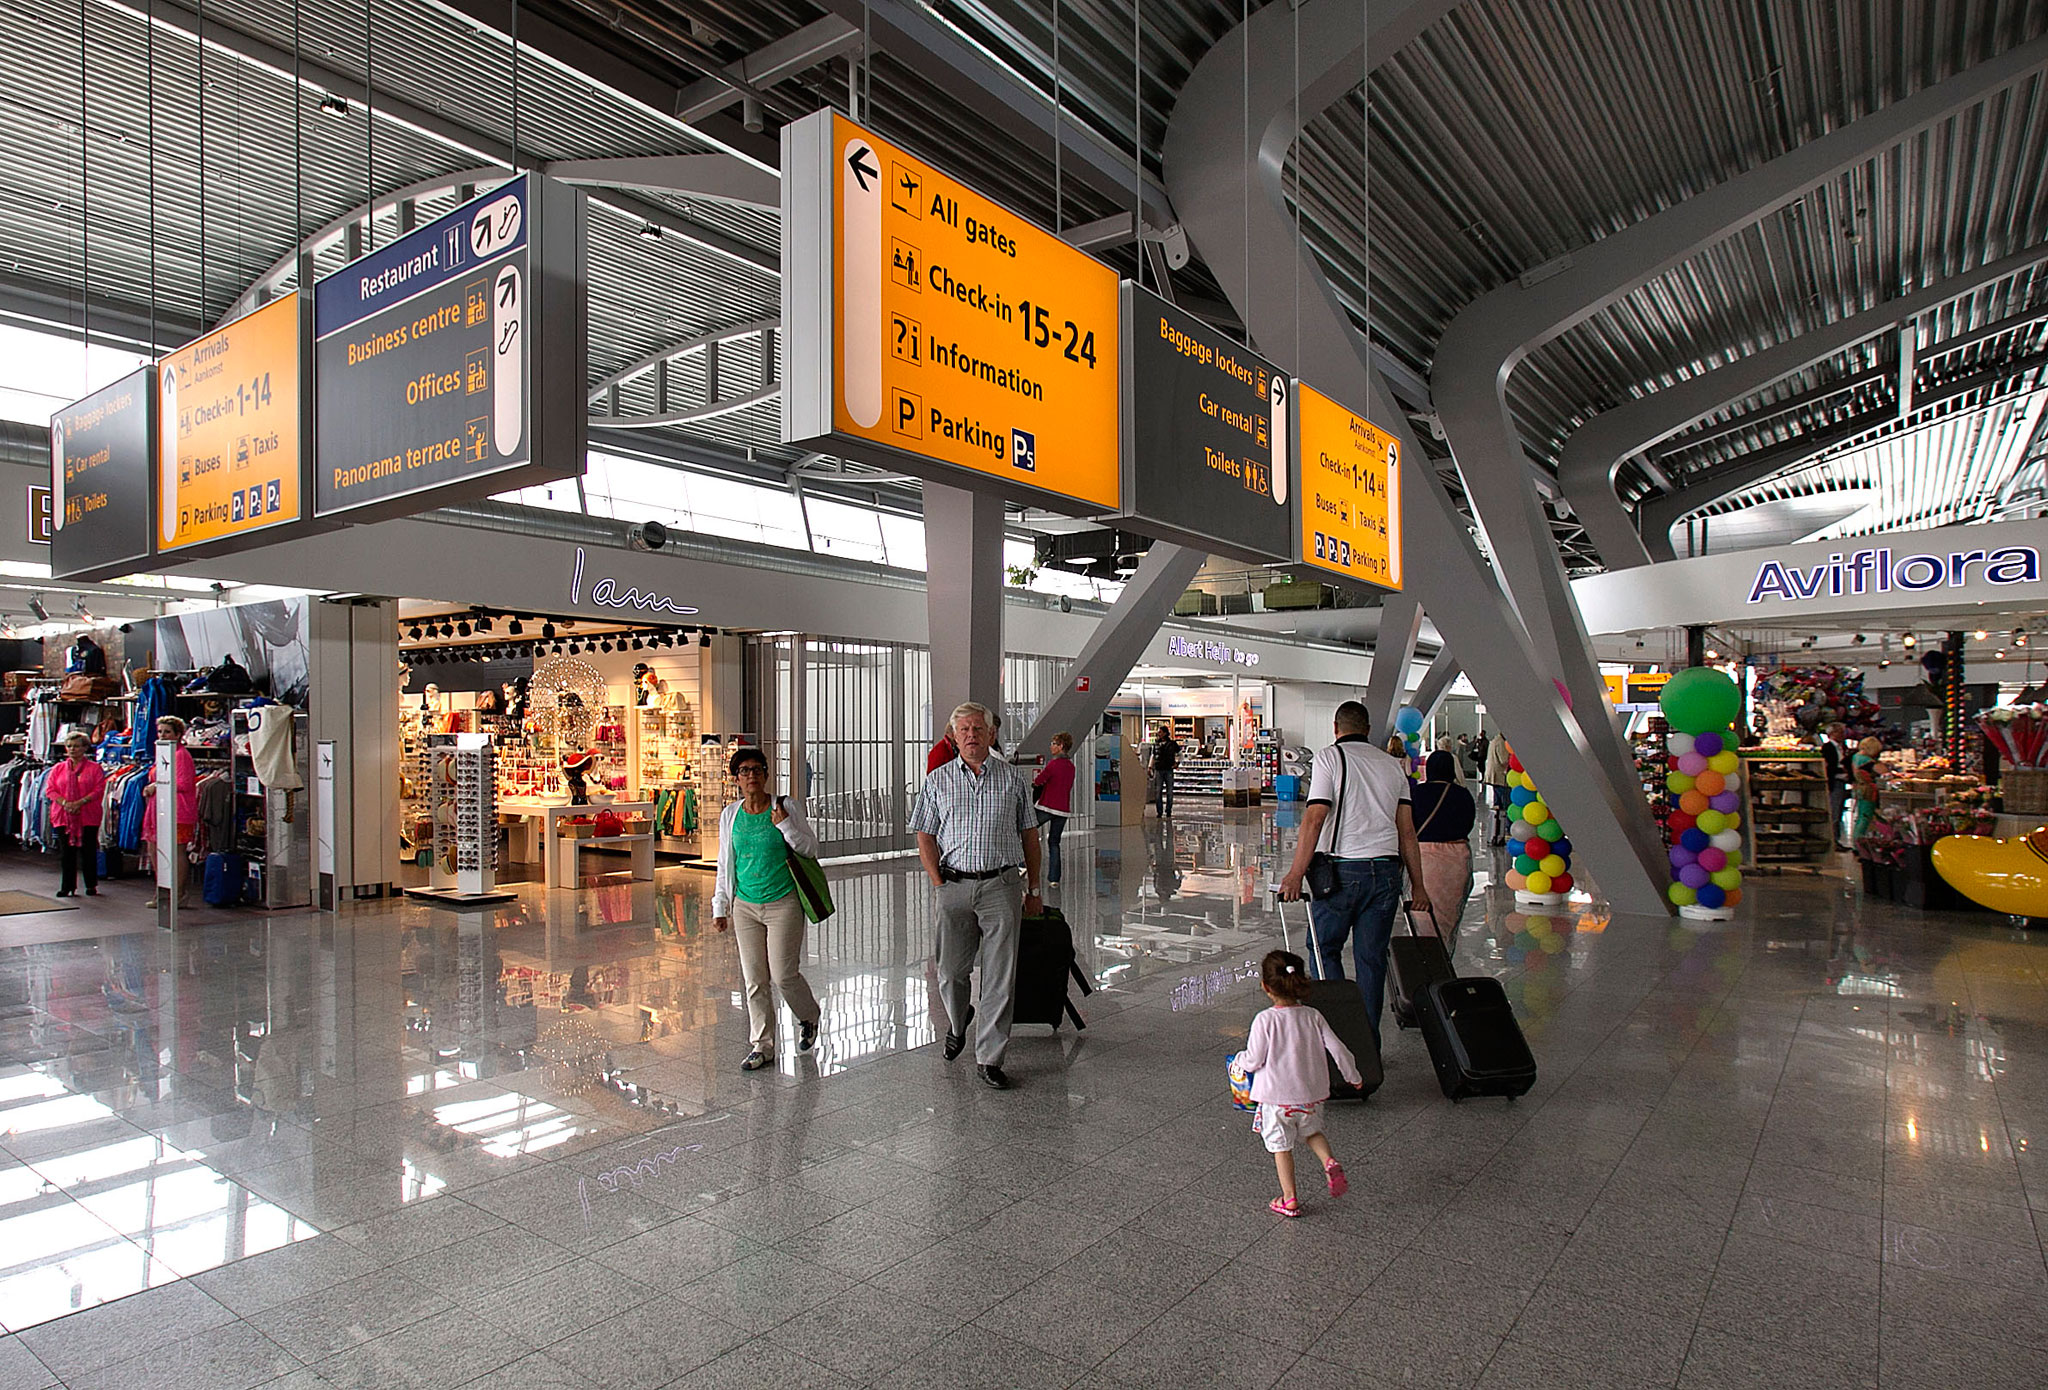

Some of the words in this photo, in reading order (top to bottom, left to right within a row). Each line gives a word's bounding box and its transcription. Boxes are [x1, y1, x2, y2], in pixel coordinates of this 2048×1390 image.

[930, 193, 959, 228] All
[965, 214, 1017, 259] gates
[361, 244, 439, 301] Restaurant
[348, 328, 407, 366] Business
[411, 302, 461, 340] centre
[929, 264, 1013, 324] Check-in
[1018, 300, 1097, 370] 15-24
[193, 334, 230, 366] Arrivals
[930, 335, 1043, 402] Information
[1160, 317, 1212, 365] Baggage
[1215, 347, 1254, 386] lockers
[194, 362, 223, 384] Aankomst
[406, 370, 461, 405] Offices
[194, 396, 234, 426] Check-in
[237, 372, 272, 416] 1-14
[1199, 393, 1219, 418] Car
[1221, 406, 1253, 434] rental
[930, 407, 1006, 460] Parking
[1013, 434, 1035, 469] P5
[1349, 417, 1376, 444] Arrivals
[75, 457, 88, 474] Car
[89, 444, 110, 468] rental
[195, 454, 221, 476] Buses
[253, 431, 279, 457] Taxis
[334, 456, 402, 490] Panorama
[406, 437, 461, 470] terrace
[1204, 446, 1241, 479] Toilets
[1320, 451, 1351, 480] Check-in
[1352, 463, 1376, 497] 1-14
[84, 493, 108, 512] Toilets
[194, 502, 228, 527] Parking
[233, 492, 244, 520] P1
[250, 488, 262, 515] P3
[267, 484, 280, 511] P4
[1316, 493, 1337, 516] Buses
[1359, 511, 1377, 531] Taxis
[1315, 534, 1325, 558] P1
[1328, 539, 1338, 563] P3
[1341, 543, 1350, 567] P4
[1353, 548, 1378, 573] Parking
[1746, 545, 2041, 604] Aviflora
[571, 547, 585, 605] I
[592, 578, 699, 615] am
[1168, 635, 1203, 659] Albert
[1205, 640, 1231, 665] Heijn
[1233, 648, 1245, 664] to
[1245, 653, 1259, 667] go
